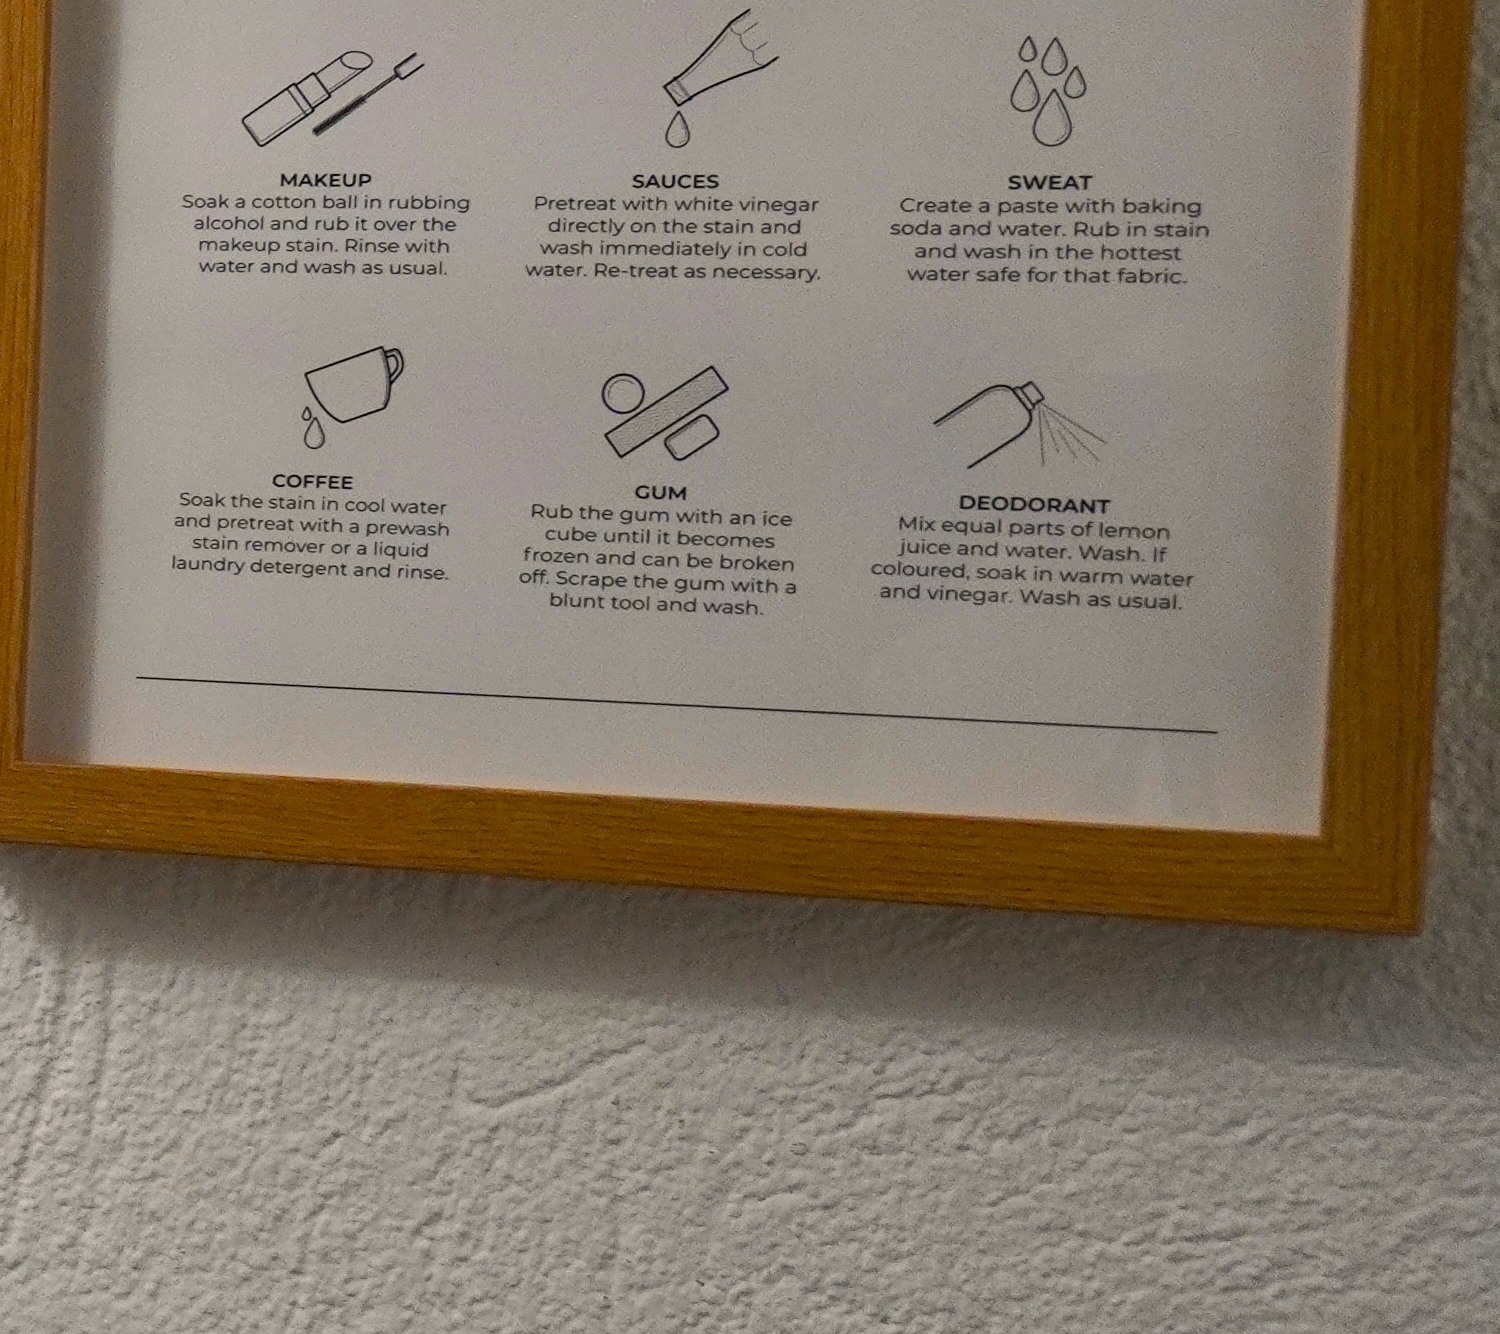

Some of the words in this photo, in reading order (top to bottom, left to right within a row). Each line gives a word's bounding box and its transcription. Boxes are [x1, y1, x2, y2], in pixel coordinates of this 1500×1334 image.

[279, 172, 372, 188] MAKEUP
[631, 173, 720, 189] SAUCES
[1007, 174, 1094, 190] SWEAT
[534, 195, 616, 211] Pretreat
[621, 196, 668, 211] with
[674, 196, 734, 212] white
[738, 195, 820, 215] vinegar
[547, 217, 625, 237] directly
[629, 221, 656, 233] on
[662, 218, 698, 234] the
[703, 218, 754, 234] stain
[760, 219, 801, 235] and
[539, 239, 593, 255] wash
[599, 239, 732, 260] immediately
[737, 241, 756, 257] in
[762, 241, 808, 257] cold
[524, 264, 587, 277] water.
[594, 262, 678, 279] Re-treat
[683, 266, 707, 279] as
[712, 266, 821, 284] necessary.
[271, 473, 353, 490] COFFEE
[633, 484, 687, 501] GUM
[958, 494, 1111, 515] DEODORANT
[898, 515, 936, 531] Mix
[941, 518, 1002, 536] equal
[1008, 521, 1065, 537] parts
[1070, 520, 1094, 537] of
[1098, 522, 1170, 540] lemon
[896, 538, 951, 557] juice
[956, 541, 999, 557] and
[1005, 545, 1072, 560] water.
[1078, 544, 1145, 562] Wash.
[1152, 546, 1167, 563] If
[870, 561, 970, 581] coloured,
[976, 565, 1027, 580] soak
[1033, 565, 1053, 582] in
[1058, 570, 1123, 584] warm
[1129, 572, 1194, 587] water
[879, 584, 921, 600] and
[926, 585, 1012, 606] vinegar.
[1019, 589, 1080, 606] Wash
[1086, 594, 1111, 608] as
[1117, 594, 1182, 610] usual.
